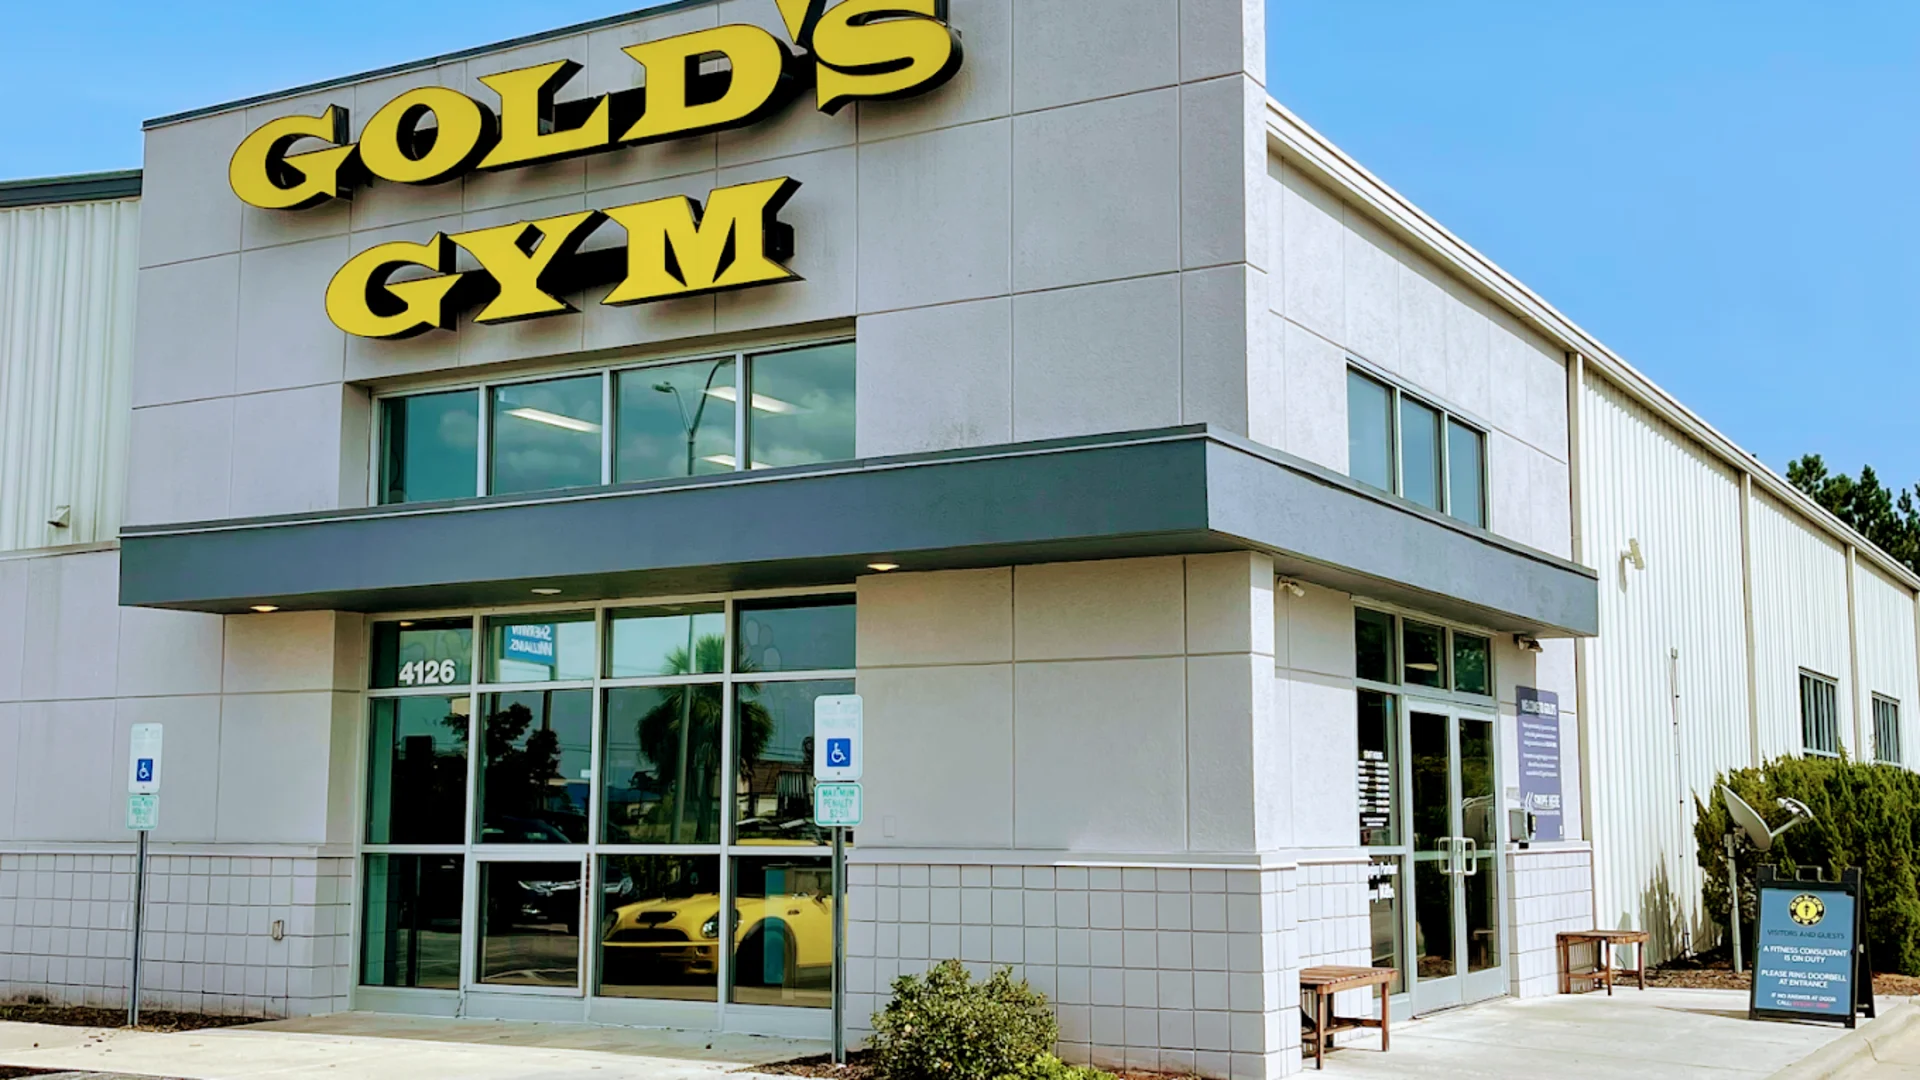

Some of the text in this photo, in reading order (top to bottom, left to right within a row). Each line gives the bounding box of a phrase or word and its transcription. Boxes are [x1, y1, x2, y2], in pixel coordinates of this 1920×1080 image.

[230, 0, 955, 210] GOLD'S
[325, 176, 804, 338] GYM
[399, 659, 456, 685] 4126
[823, 799, 853, 807] PENALTY
[1766, 929, 1797, 937] VISITORS
[1817, 931, 1845, 939] GUESTS
[1770, 945, 1798, 954] FITNESS
[1799, 946, 1848, 957] CONSULTANT
[1805, 955, 1826, 963] DUTY
[1761, 969, 1847, 982] PLEASE RING DOORBELL
[1789, 979, 1828, 988] ENTRANCE
